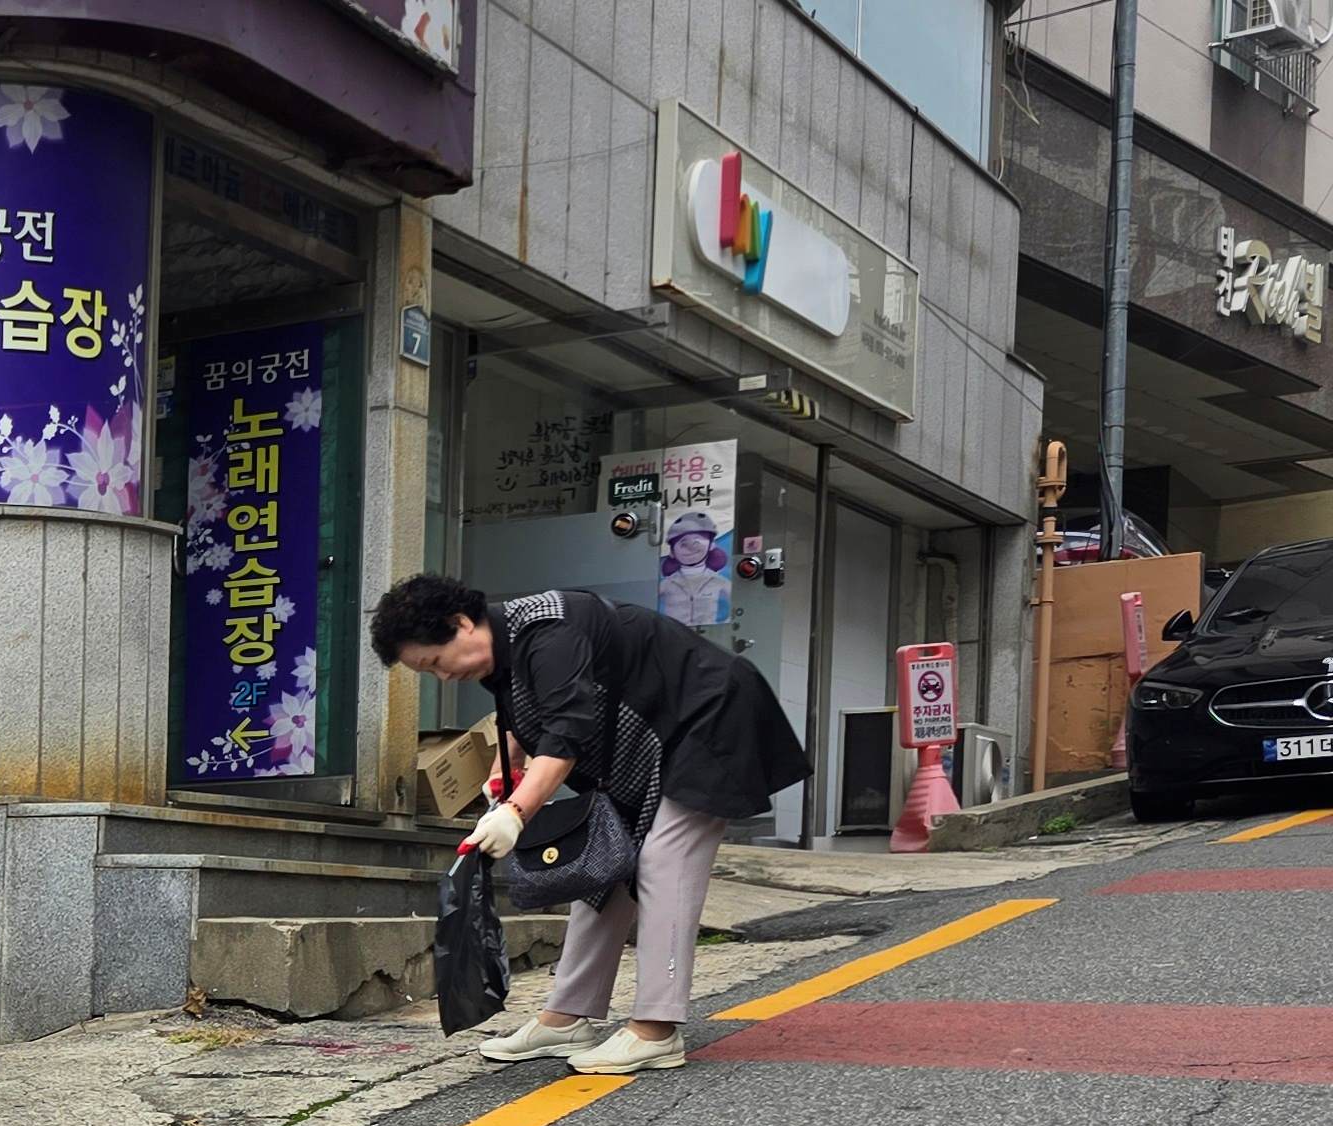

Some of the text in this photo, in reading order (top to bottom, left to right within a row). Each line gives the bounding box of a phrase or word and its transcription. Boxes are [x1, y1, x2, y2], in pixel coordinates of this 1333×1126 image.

[412, 333, 421, 354] 7
[202, 349, 311, 391] 꿈의궁전
[614, 478, 654, 495] Fredit
[672, 484, 713, 507] 시작
[222, 397, 284, 666] 노래연습장
[232, 681, 271, 707] 2F
